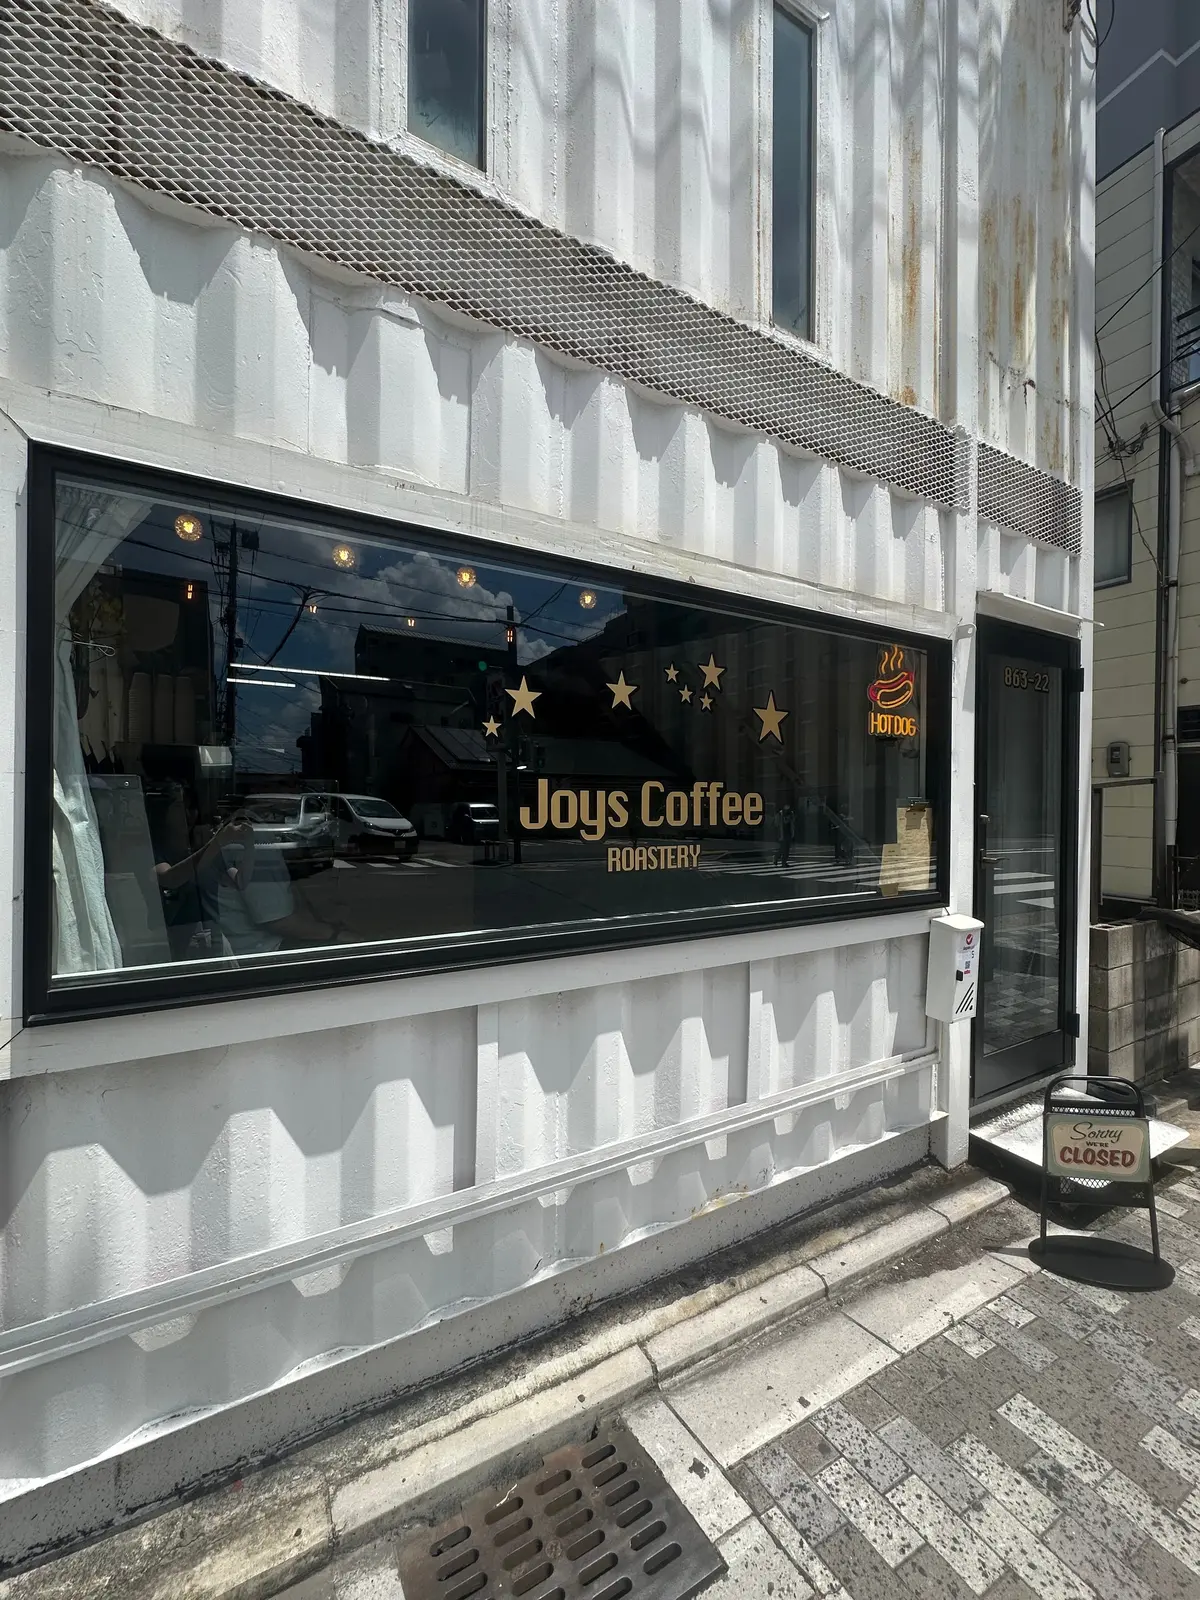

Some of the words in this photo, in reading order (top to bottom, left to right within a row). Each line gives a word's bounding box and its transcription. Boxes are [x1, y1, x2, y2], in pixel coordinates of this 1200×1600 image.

[1004, 666, 1049, 692] 863-22
[519, 778, 629, 841] Joys
[641, 780, 763, 827] Coffee
[607, 844, 701, 872] ROASTERY
[1070, 1121, 1123, 1143] Sorry
[1060, 1146, 1135, 1167] CLOSED
